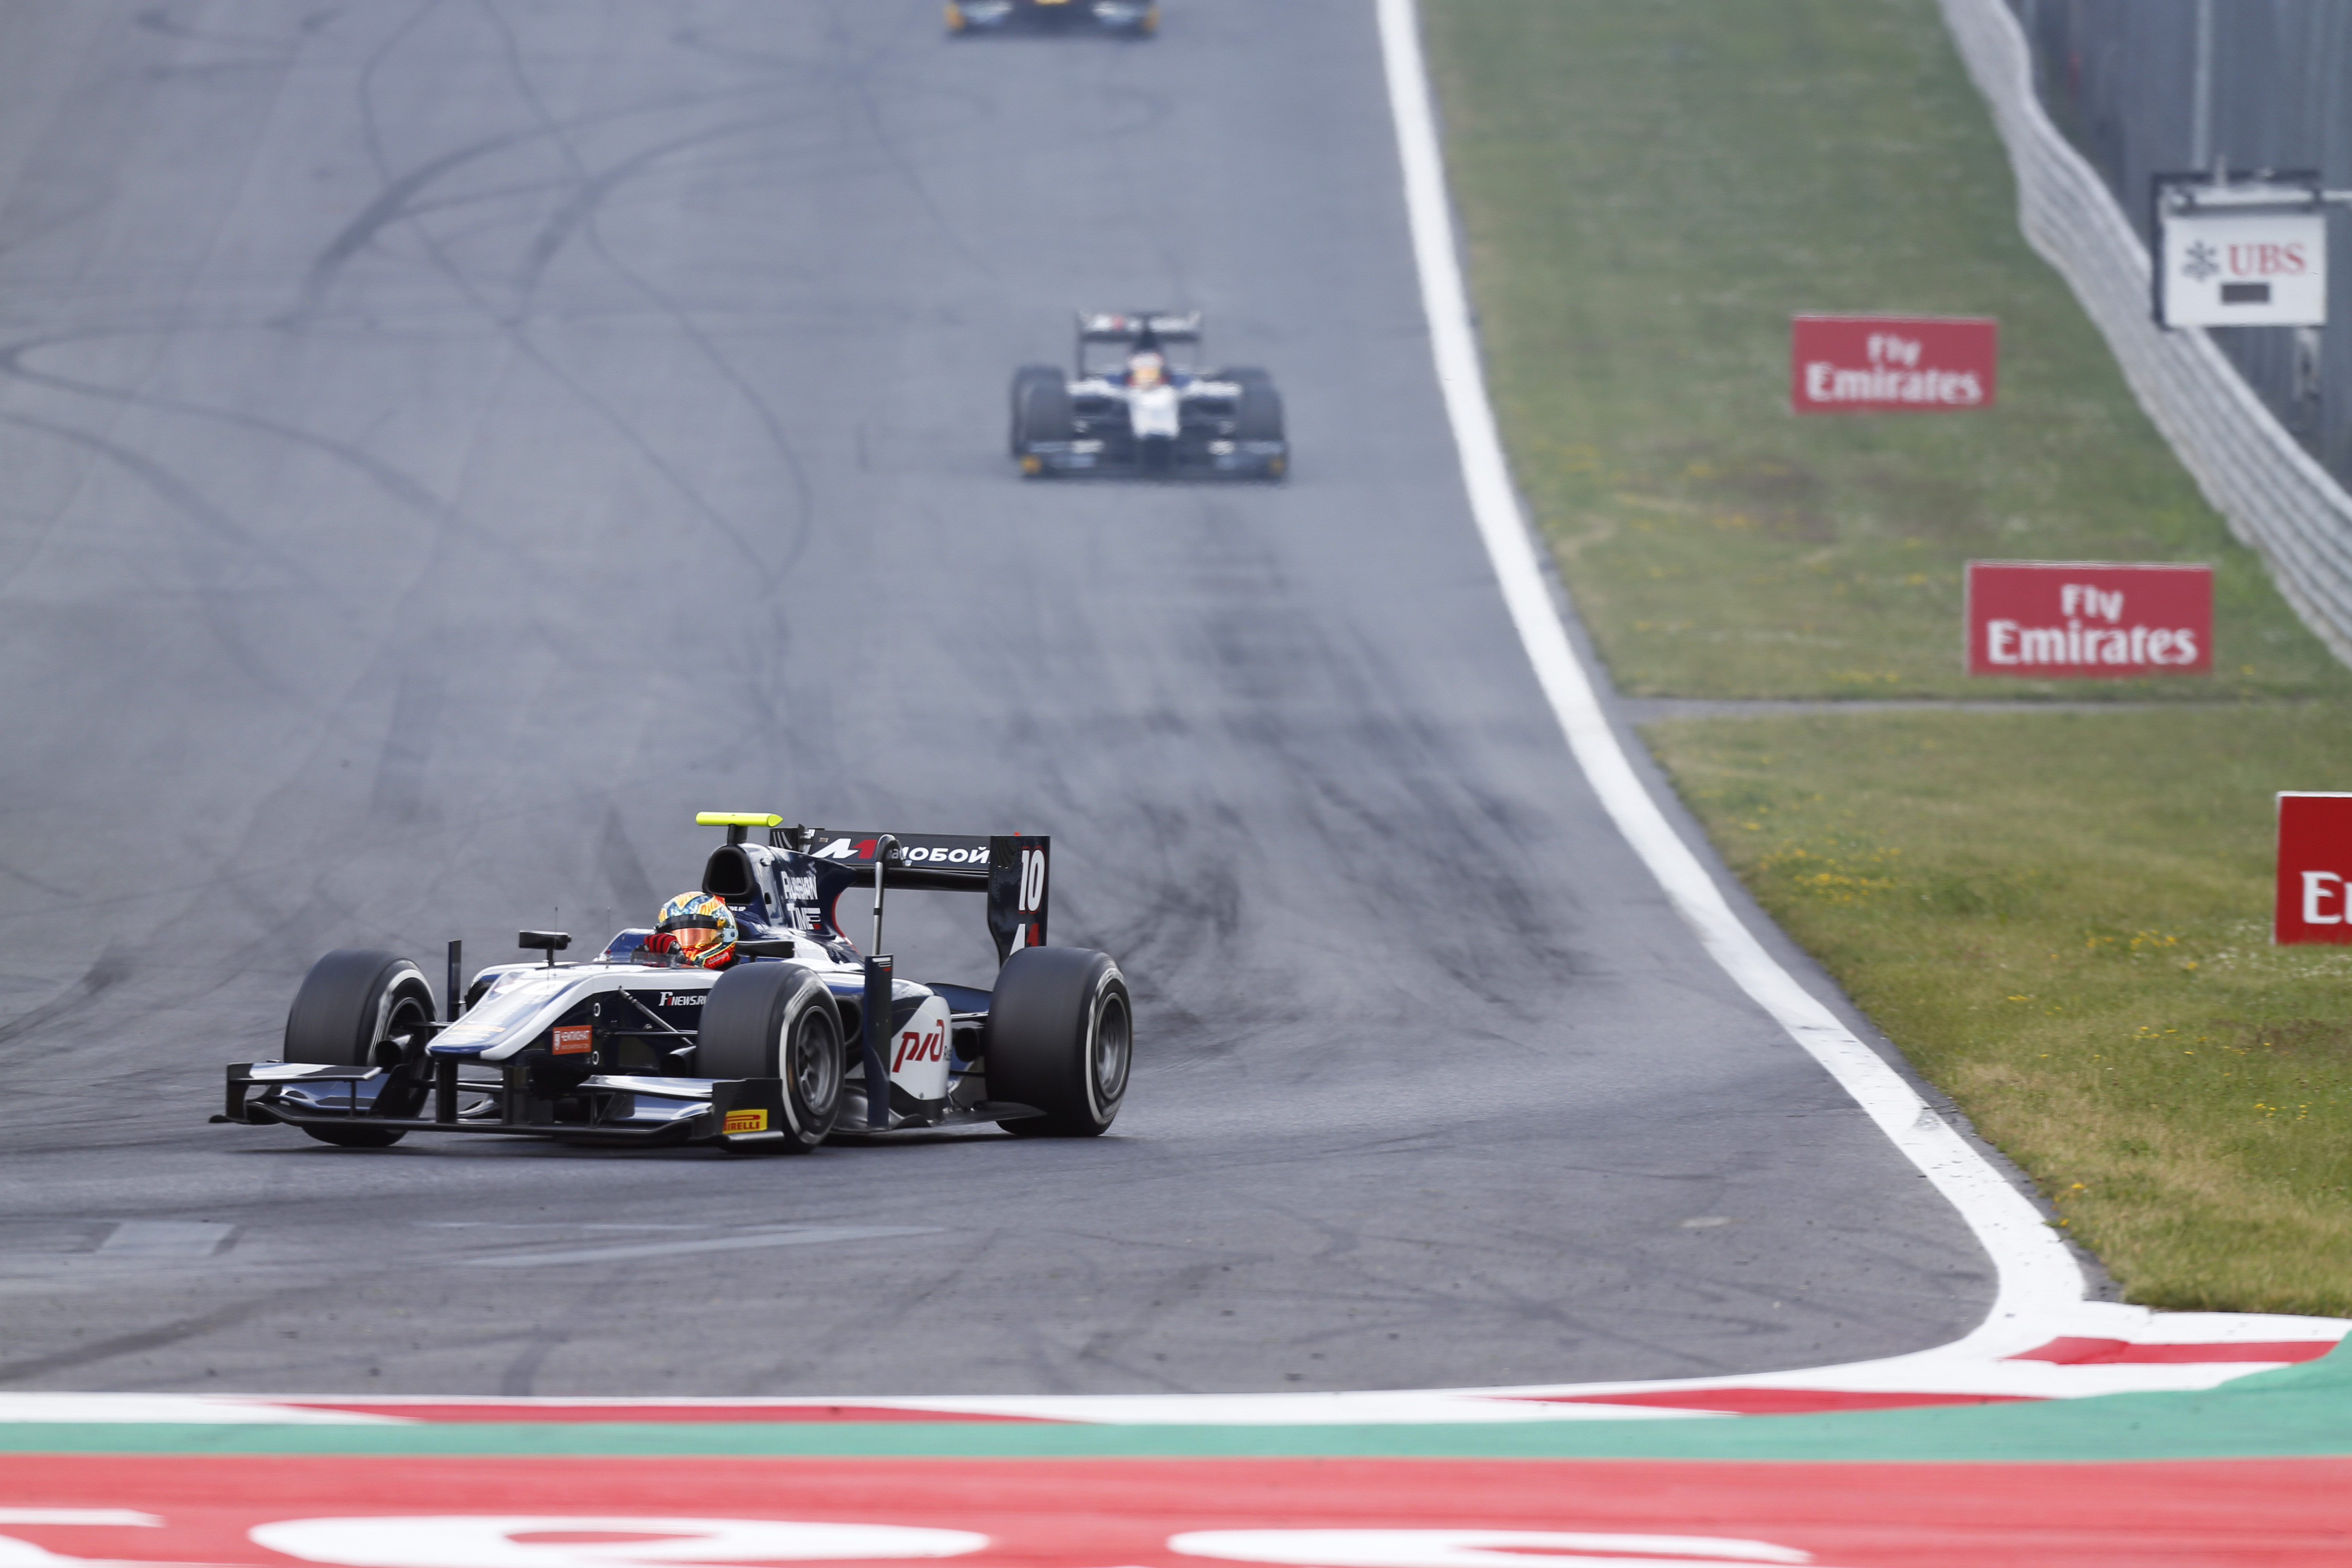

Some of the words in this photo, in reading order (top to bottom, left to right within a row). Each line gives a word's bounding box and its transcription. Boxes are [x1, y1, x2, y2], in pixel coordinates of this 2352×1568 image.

[2228, 241, 2307, 277] UBS
[1866, 333, 1923, 367] Fly
[1805, 362, 1983, 404] Emirates
[2060, 583, 2125, 623] Fly
[1986, 618, 2199, 665] Emirates
[780, 871, 818, 900] RUSSIAN
[1019, 847, 1045, 912] 10
[2301, 871, 2352, 925] E
[786, 903, 821, 930] TIME
[723, 1115, 760, 1131] PIRELLI
